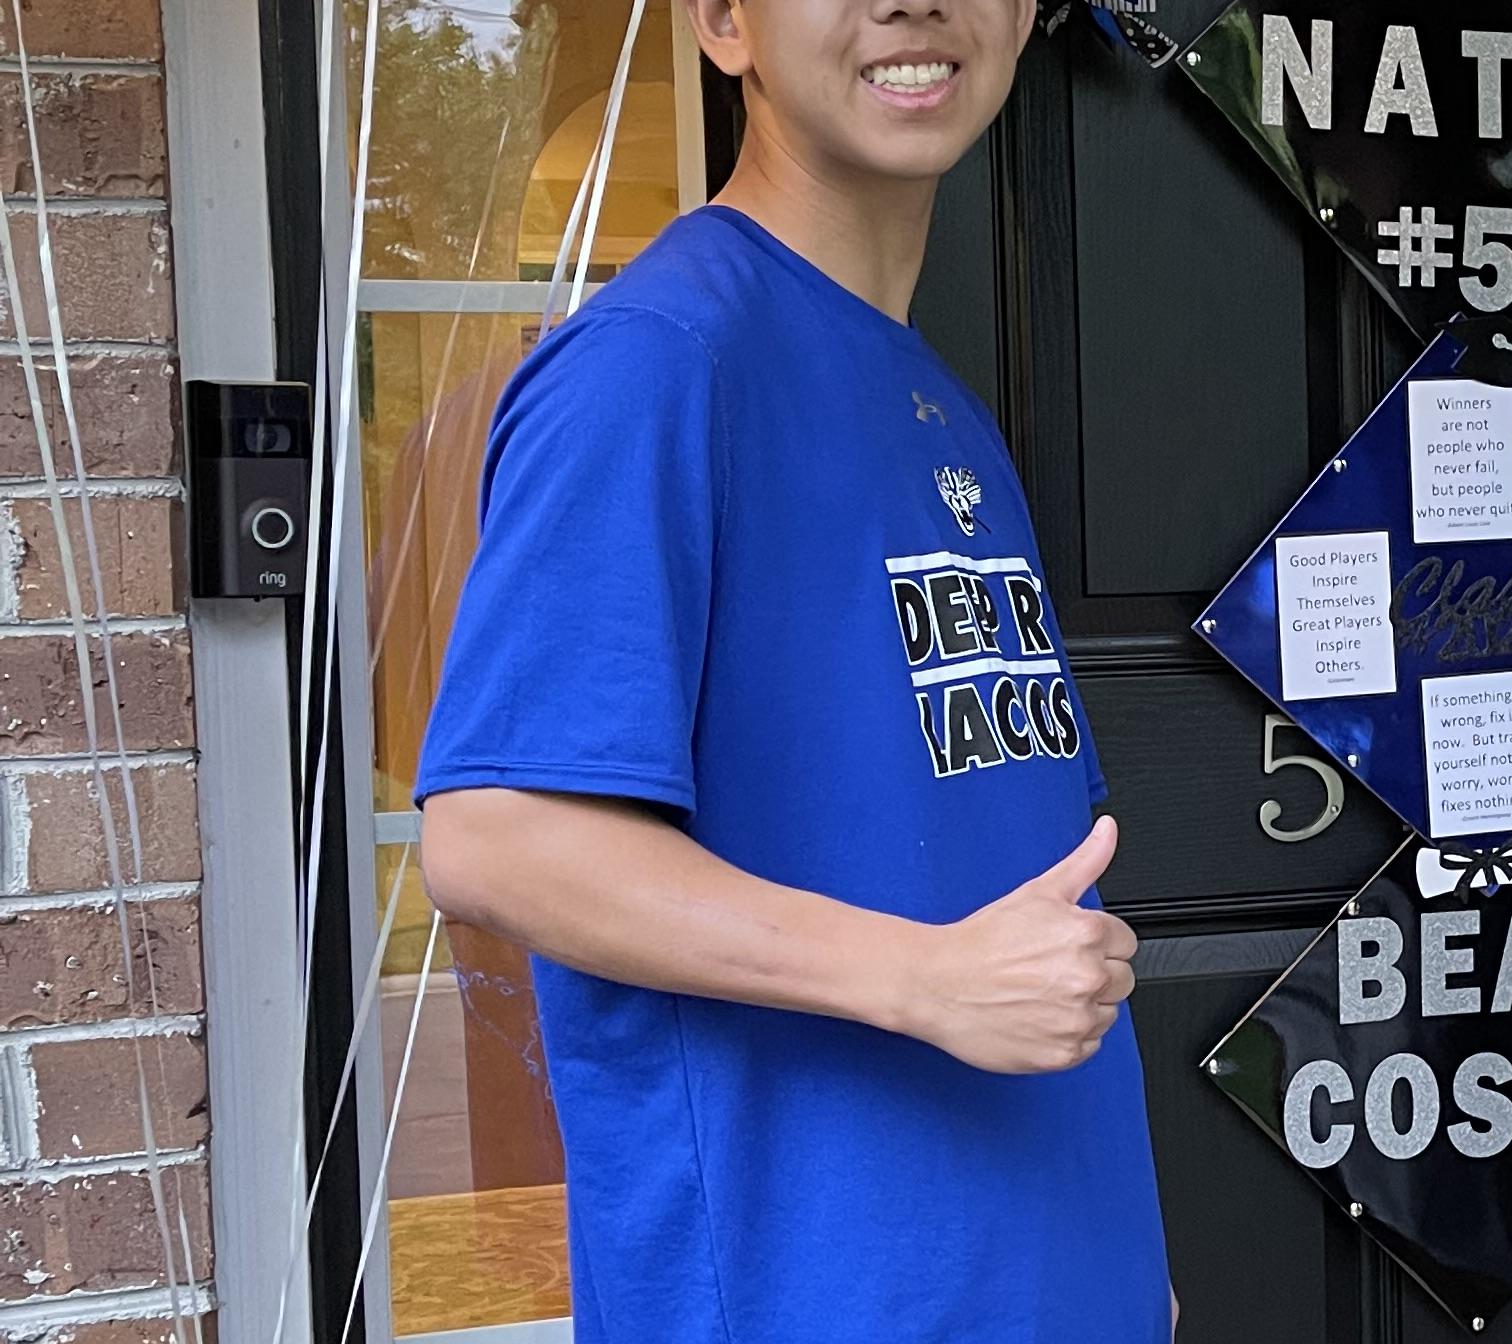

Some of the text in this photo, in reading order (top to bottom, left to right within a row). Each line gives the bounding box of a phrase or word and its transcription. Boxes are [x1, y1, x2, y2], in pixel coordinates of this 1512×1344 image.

[1436, 397, 1492, 411] Winners
[1441, 419, 1489, 432] are not
[1427, 439, 1505, 456] people who
[1434, 460, 1499, 475] never fail,
[1432, 481, 1503, 498] but people
[1416, 504, 1445, 519] who
[1449, 505, 1486, 517] never
[1289, 551, 1378, 568] Good Players
[259, 570, 286, 588] ring
[1312, 574, 1358, 589] Inspire
[1296, 594, 1376, 610] Themselves
[1292, 615, 1383, 632] Great Players
[1316, 637, 1362, 653] Inspire
[1430, 694, 1439, 708] If
[1443, 690, 1512, 707] something
[1441, 715, 1487, 728] wrong,
[1490, 710, 1505, 723] fix
[1432, 738, 1464, 750] now.
[1472, 733, 1495, 747] But
[1433, 754, 1487, 773] yourself
[1491, 753, 1512, 766] not
[1259, 714, 1345, 843] 5
[1441, 778, 1484, 792] worry,
[1441, 799, 1471, 813] fixes
